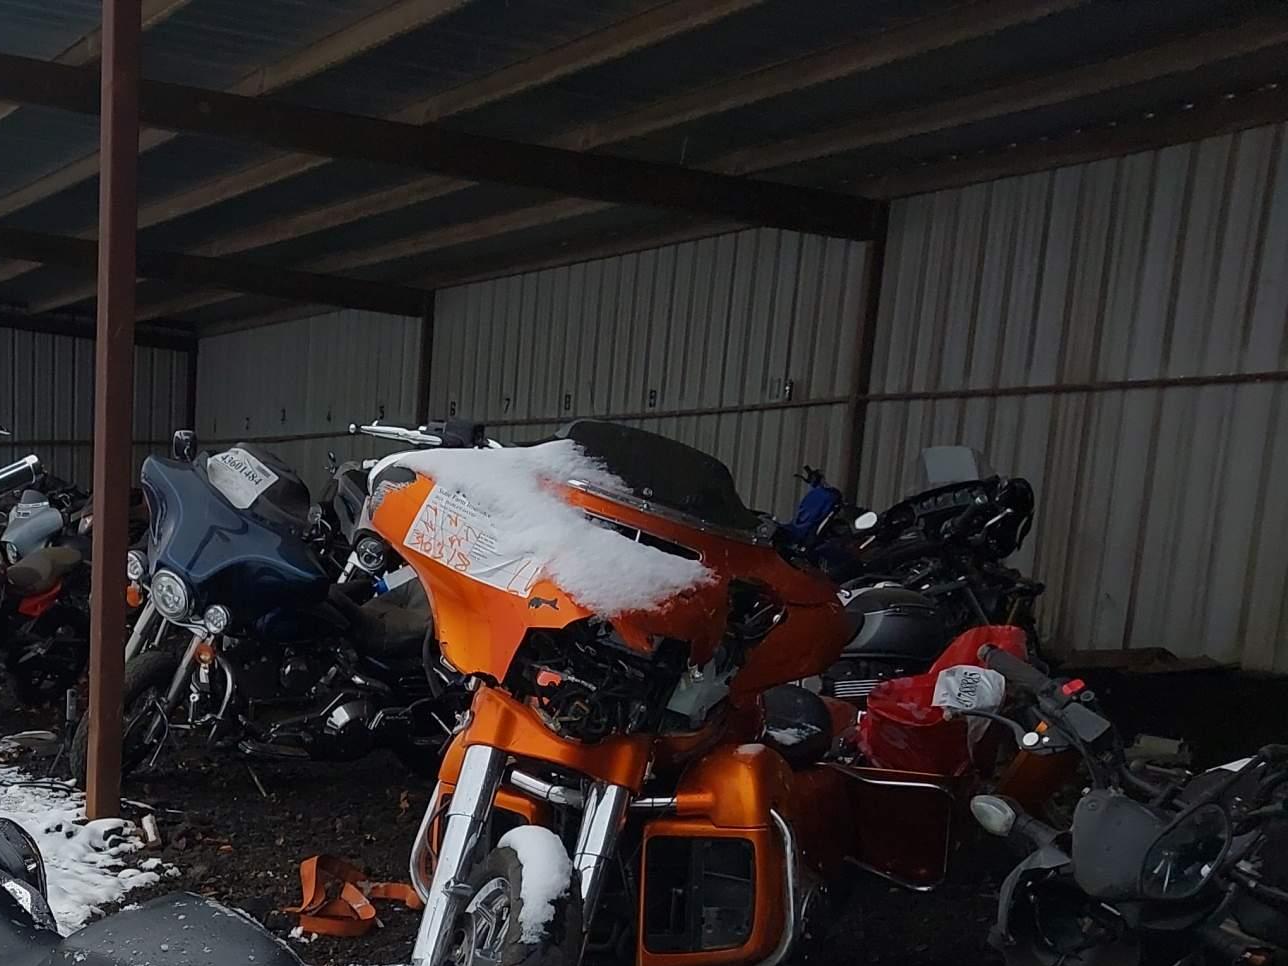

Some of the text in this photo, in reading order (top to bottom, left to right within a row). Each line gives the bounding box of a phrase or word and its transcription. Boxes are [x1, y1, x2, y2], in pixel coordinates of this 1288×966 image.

[449, 400, 457, 417] 6
[503, 397, 511, 414] 7
[564, 394, 572, 410] 8
[378, 405, 385, 420] 5
[220, 454, 263, 485] 43601484
